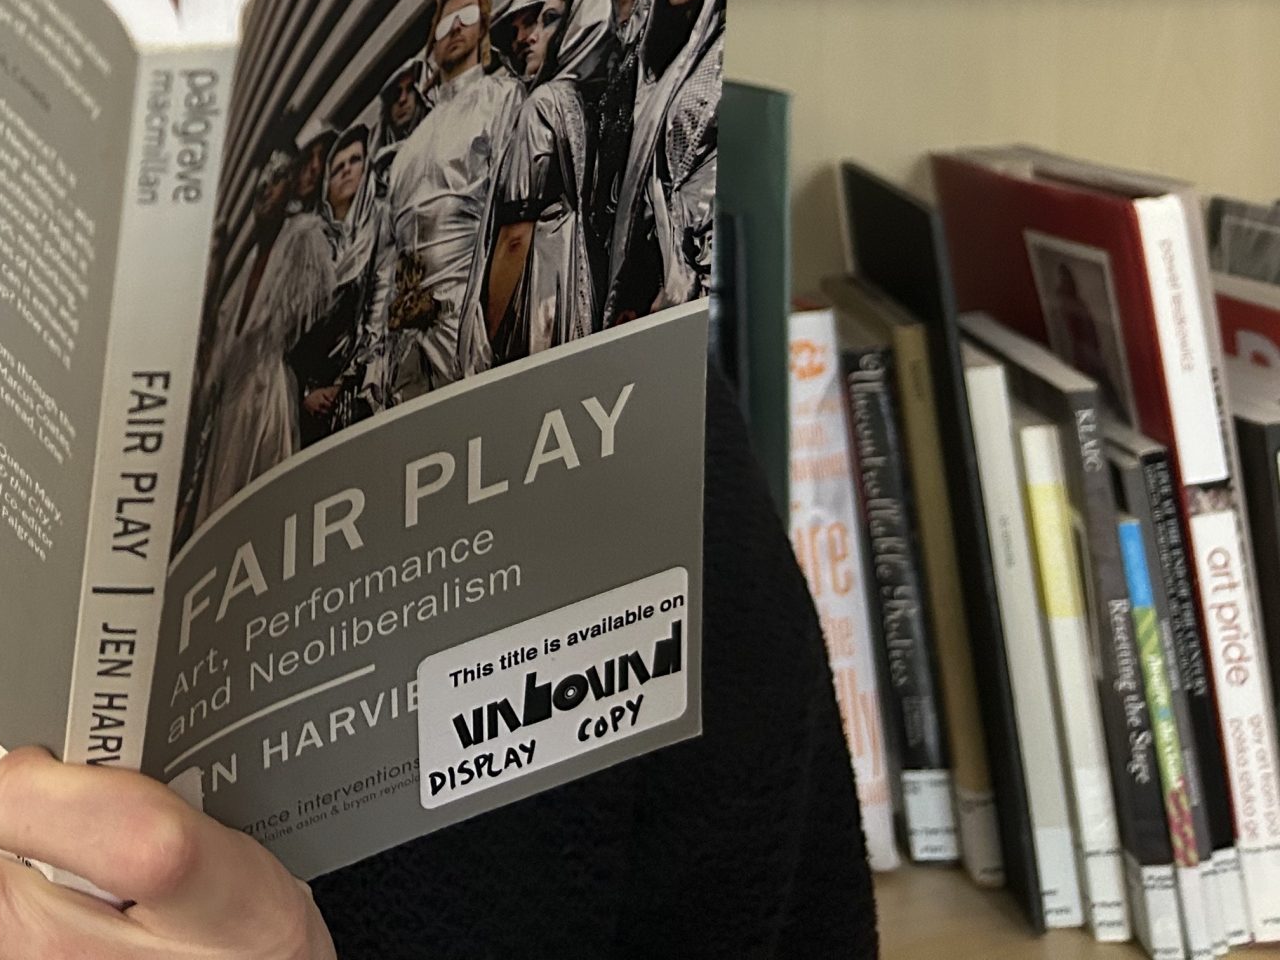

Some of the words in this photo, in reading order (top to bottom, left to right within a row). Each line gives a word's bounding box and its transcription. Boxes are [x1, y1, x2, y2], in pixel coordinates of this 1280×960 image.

[137, 69, 173, 205] macmillan
[172, 68, 220, 205] palgrave
[17, 362, 57, 414] through
[123, 370, 171, 455] FAIR
[34, 482, 62, 519] Mary,
[848, 353, 911, 578] Uncontrollable
[111, 472, 158, 560] PLAY
[179, 487, 366, 654] FAIR
[405, 382, 635, 529] PLAY
[1206, 548, 1239, 594] art
[96, 622, 138, 679] JEN
[168, 677, 232, 744] and
[250, 563, 521, 693] Neoliberalism
[170, 649, 229, 707] Art,
[245, 529, 495, 651] Performance
[449, 660, 494, 688] This
[499, 644, 538, 670] title
[543, 638, 561, 655] is
[566, 604, 655, 646] available
[660, 594, 685, 613] on
[1108, 598, 1139, 691] Resetting
[1209, 602, 1254, 688] pride
[86, 691, 129, 766] HARV
[263, 678, 420, 770] HARVIE
[428, 739, 537, 797] DISPLAY
[577, 694, 644, 742] COPY
[1125, 695, 1146, 727] the
[297, 757, 420, 816] interventions
[343, 793, 377, 812] bryan
[380, 775, 420, 799] reynol
[1127, 730, 1154, 784] Stage
